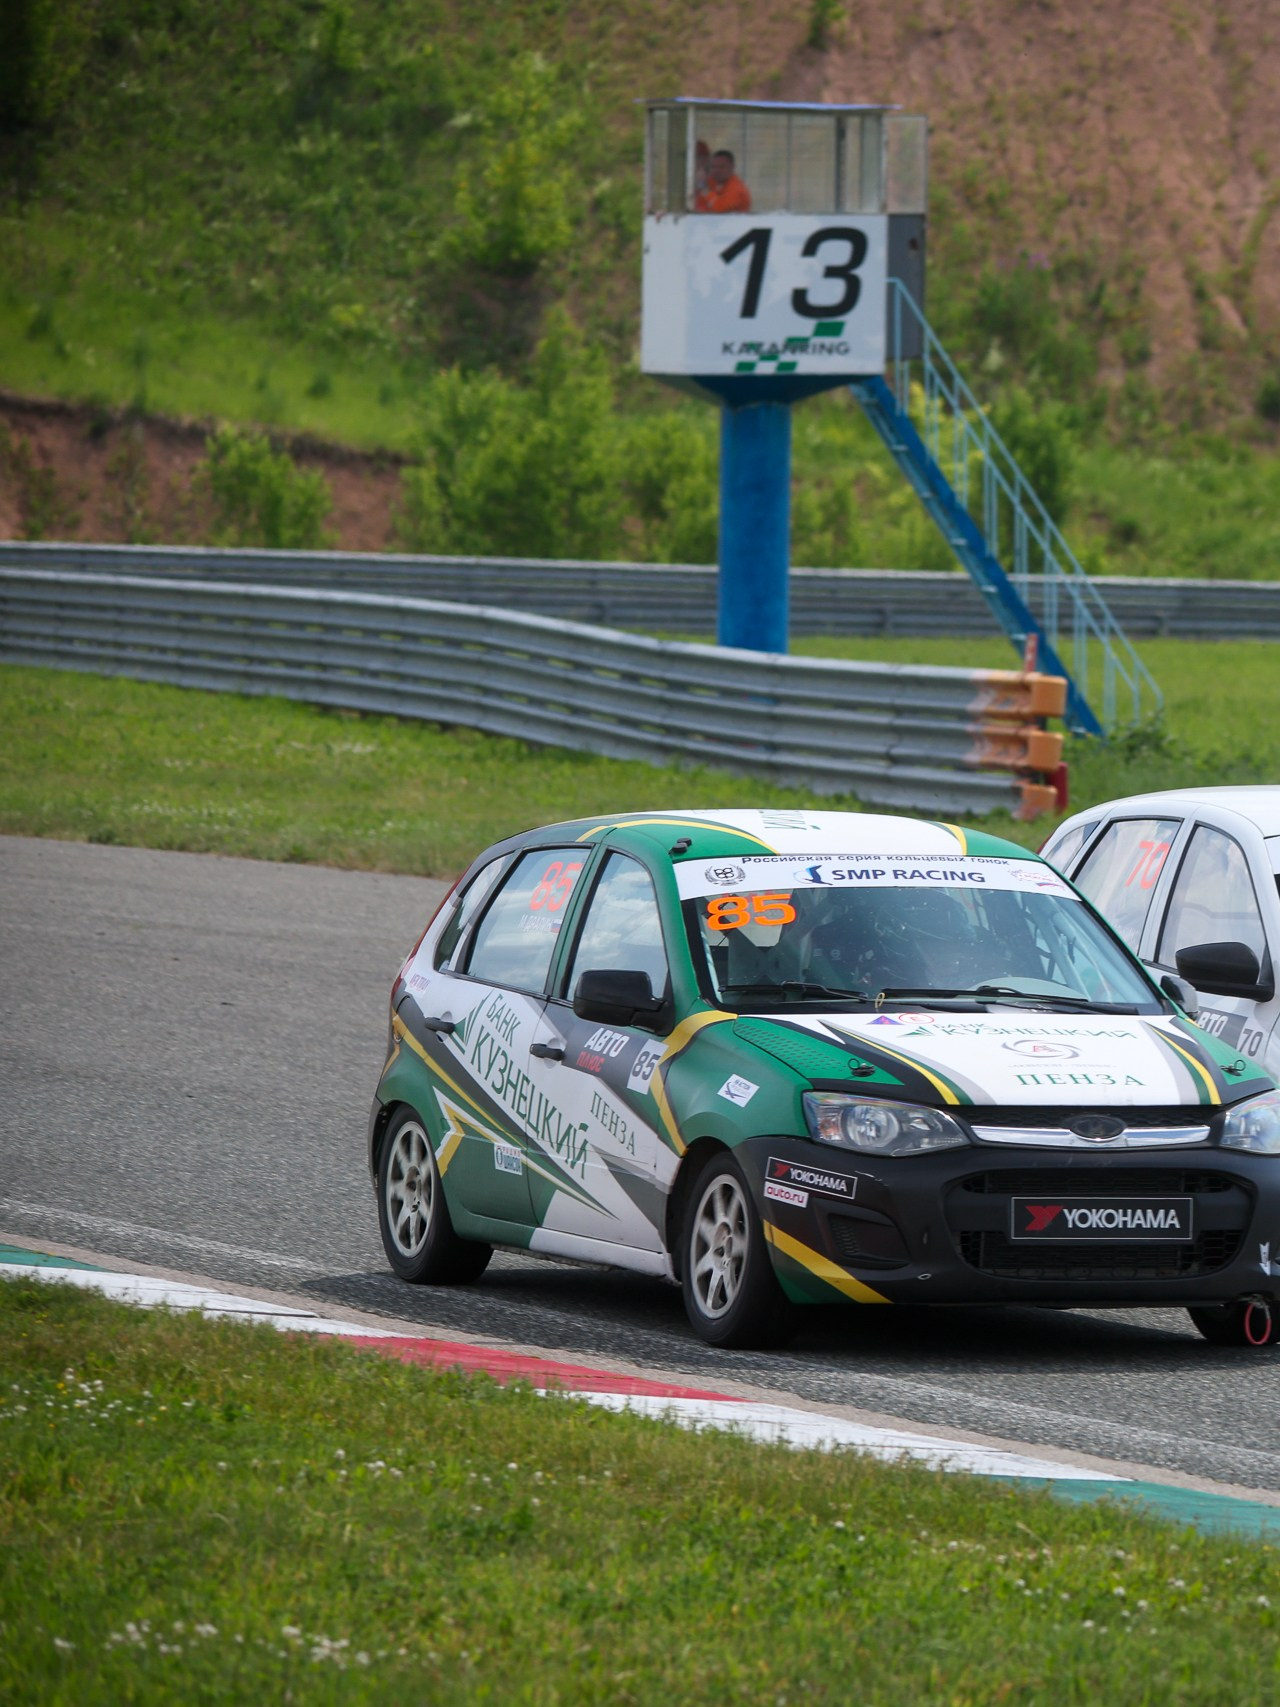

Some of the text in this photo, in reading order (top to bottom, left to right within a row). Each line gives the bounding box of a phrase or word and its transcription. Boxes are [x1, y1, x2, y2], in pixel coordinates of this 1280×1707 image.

[719, 226, 869, 319] 13
[721, 340, 850, 356] KAZANRING
[741, 855, 1010, 866] Российская серия кольцевых гонок
[1124, 840, 1170, 890] 70
[529, 861, 584, 912] 85
[831, 869, 986, 883] SMP RACING
[706, 893, 797, 931] 85
[486, 993, 521, 1047] БАНК
[940, 1028, 1138, 1039] КУЗНЕЦКИЙ
[1198, 1011, 1229, 1038] ВТО
[584, 1027, 630, 1058] АВТО
[1239, 1028, 1263, 1057] 70
[631, 1050, 661, 1080] 85
[1014, 1073, 1145, 1087] ПЕНЗА
[470, 1024, 589, 1180] КУЗНЕЦКИЙ
[590, 1090, 635, 1156] ПЕНЗА
[767, 1185, 806, 1203] auto.ru
[790, 1167, 848, 1192] YOKOHAMA
[1062, 1208, 1181, 1229] YOKOHAMA
